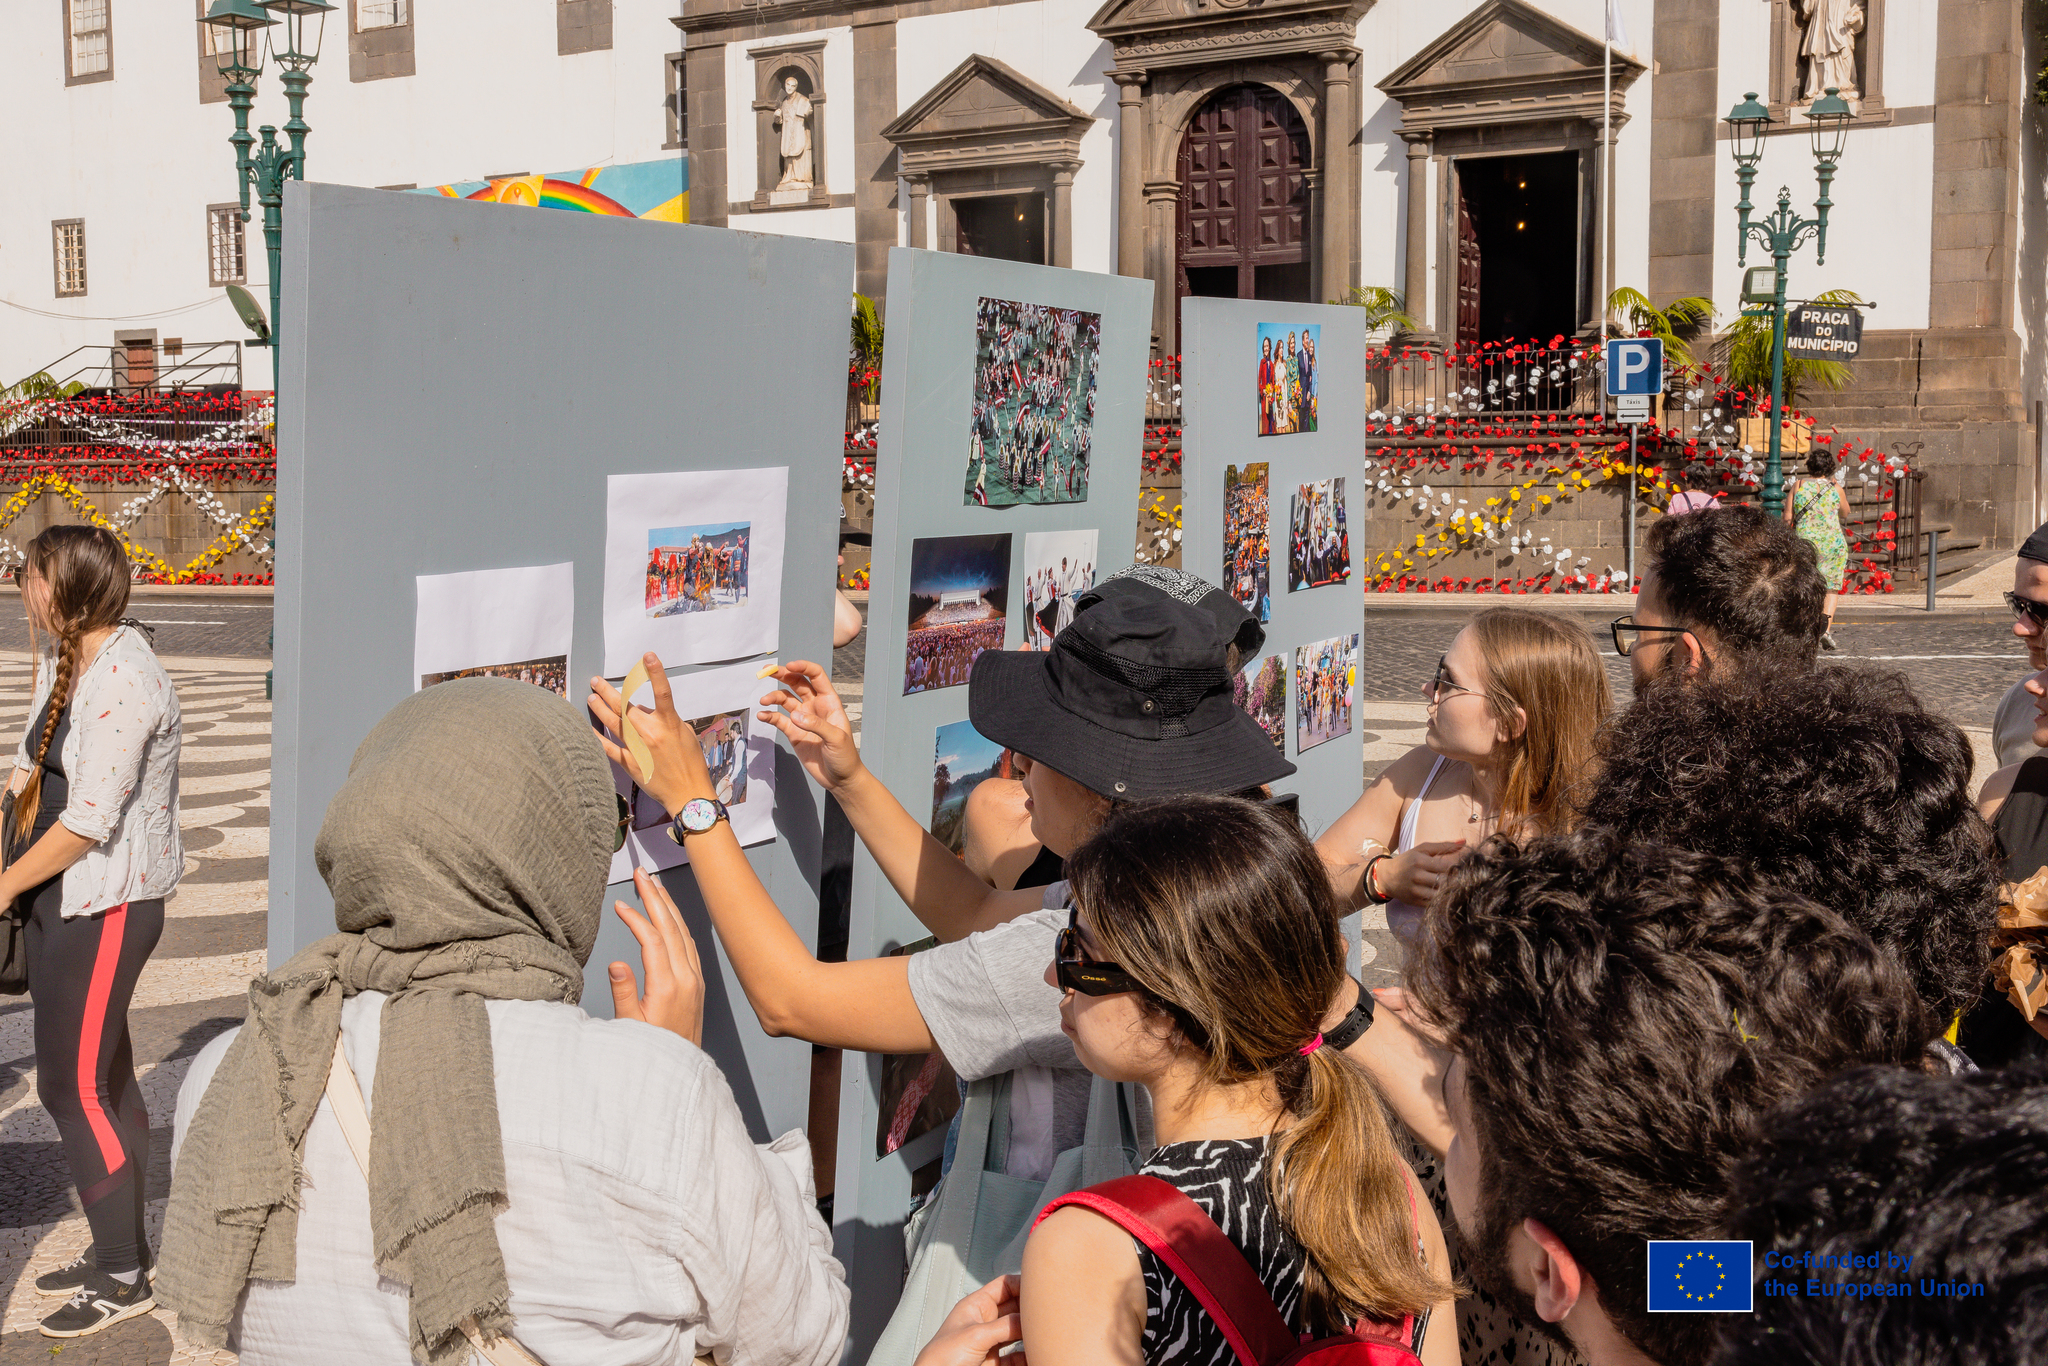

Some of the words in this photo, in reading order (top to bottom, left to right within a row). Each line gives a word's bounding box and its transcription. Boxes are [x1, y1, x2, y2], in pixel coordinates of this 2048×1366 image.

[1815, 326, 1833, 337] DO
[1787, 336, 1858, 353] MUNICÍPIO
[1619, 344, 1650, 391] P
